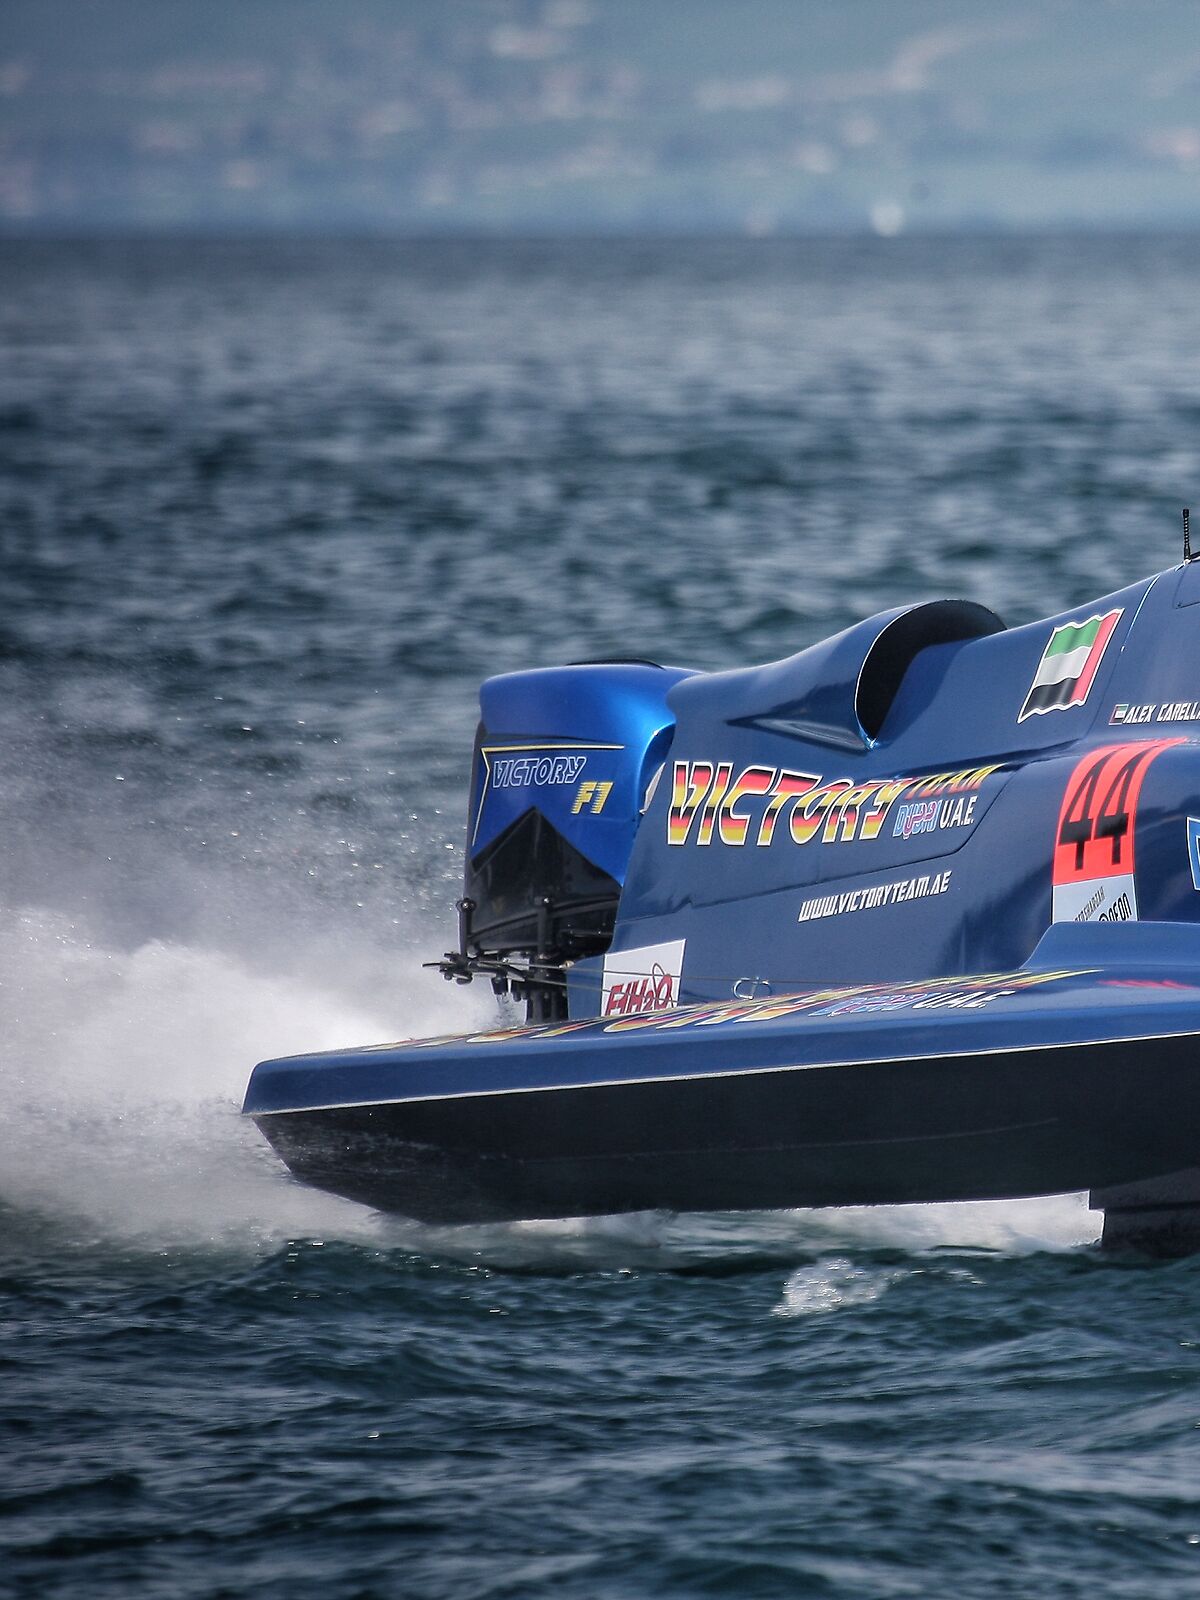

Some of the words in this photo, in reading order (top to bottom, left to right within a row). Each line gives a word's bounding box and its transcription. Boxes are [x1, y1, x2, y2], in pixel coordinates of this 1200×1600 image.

[1123, 705, 1157, 724] ALEX
[493, 756, 587, 788] VICTORY
[570, 782, 614, 815] F1
[667, 760, 917, 846] VICTORY
[1058, 746, 1153, 871] 44
[798, 870, 953, 923] WWW.VICTORYTEAM.AE
